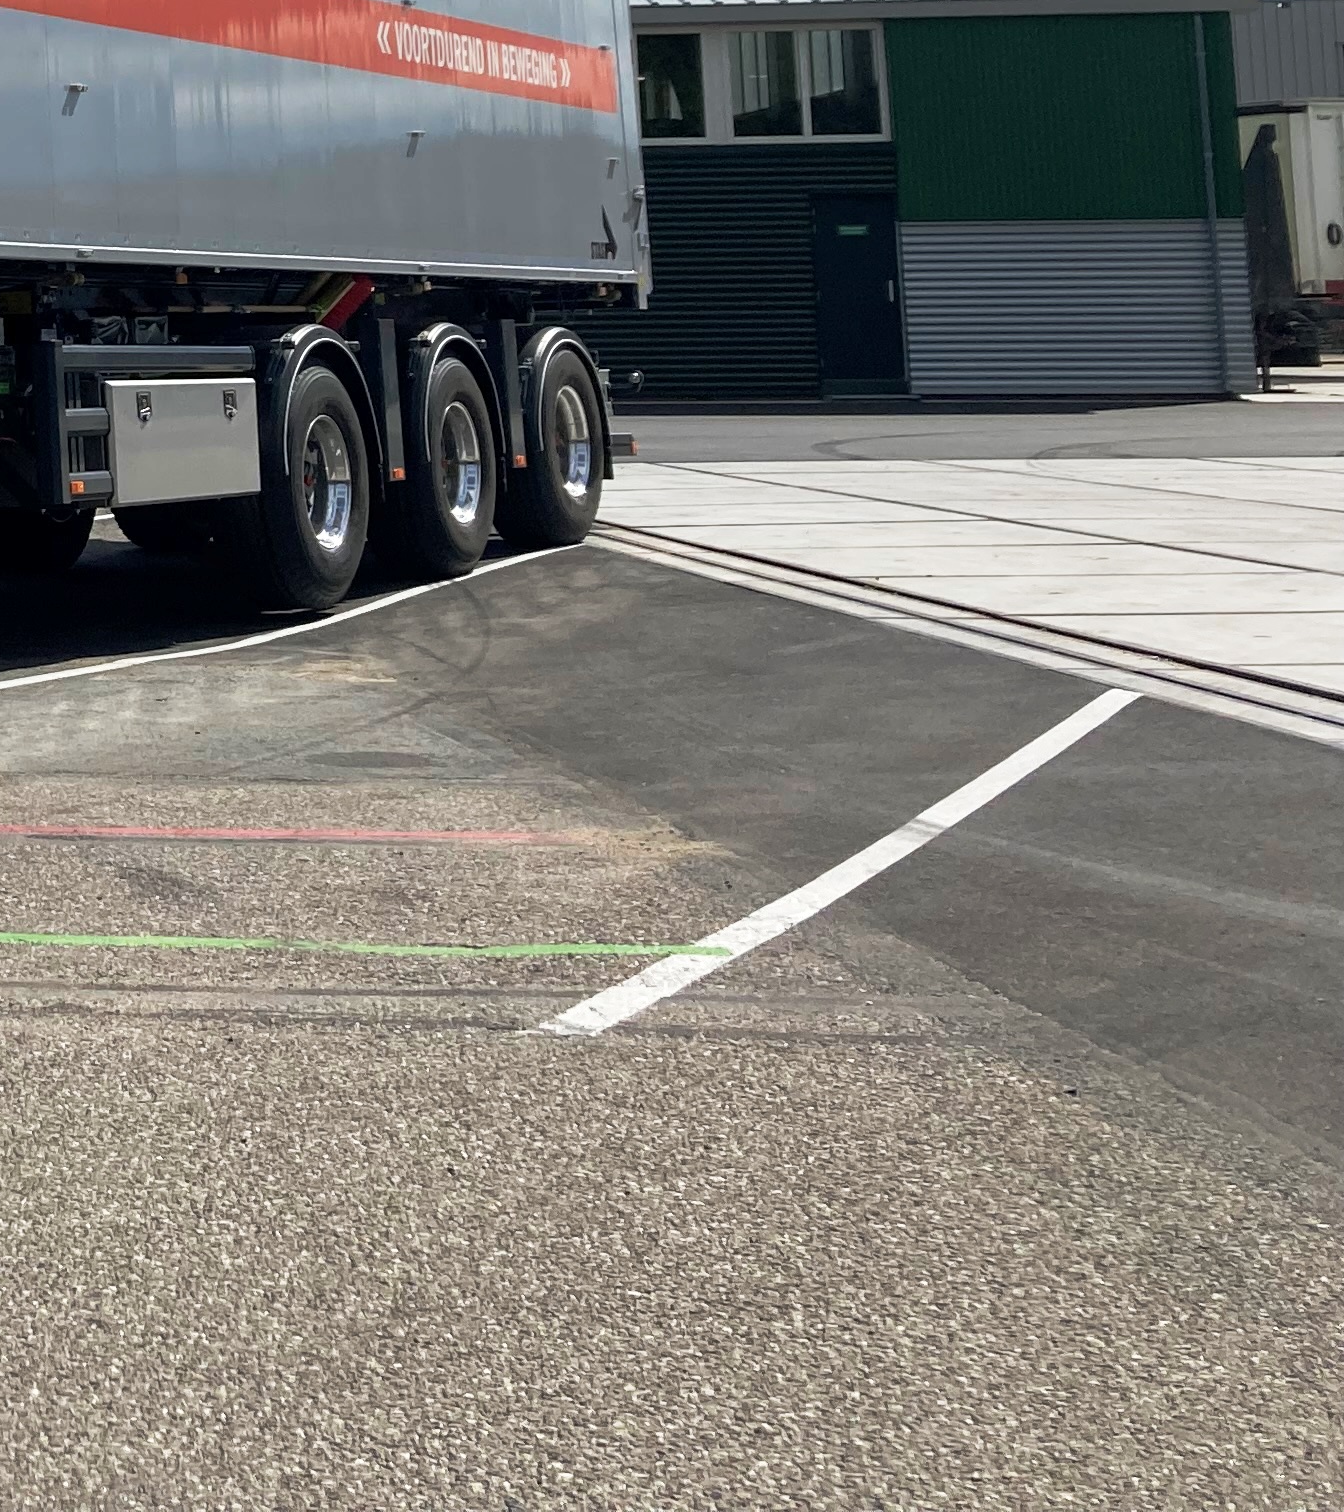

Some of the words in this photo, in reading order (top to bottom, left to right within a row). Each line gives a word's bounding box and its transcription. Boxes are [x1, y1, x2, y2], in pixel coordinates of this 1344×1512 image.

[394, 20, 484, 75] VOORTDUREND
[486, 40, 500, 78] IN
[501, 43, 558, 88] BEWEGING
